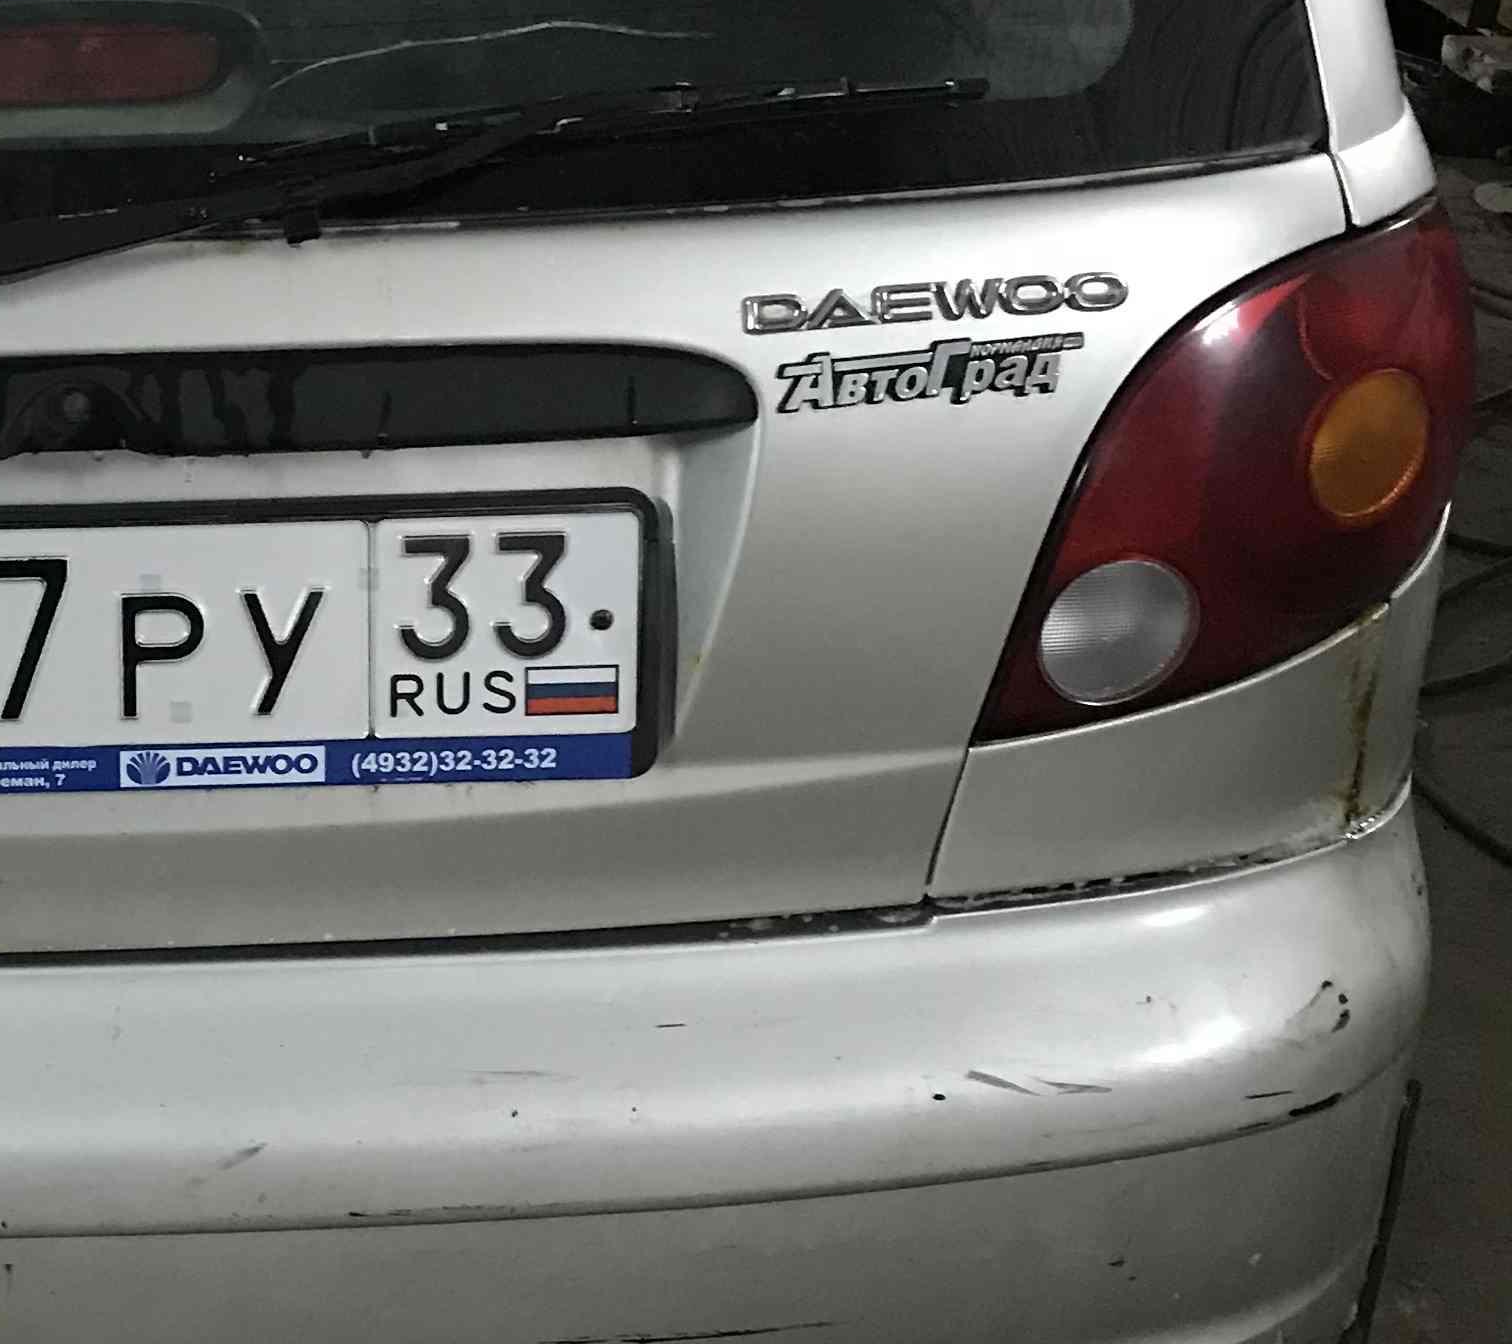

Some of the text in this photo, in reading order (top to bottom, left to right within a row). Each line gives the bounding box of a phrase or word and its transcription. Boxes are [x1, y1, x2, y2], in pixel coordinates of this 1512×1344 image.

[740, 271, 1130, 336] DAEWOO
[399, 531, 568, 660] 33
[389, 669, 517, 718] RUS
[52, 759, 97, 772] дилер
[175, 752, 321, 777] DAEWOO
[350, 747, 558, 779] (4932)32-32-32
[55, 773, 67, 786] 7
